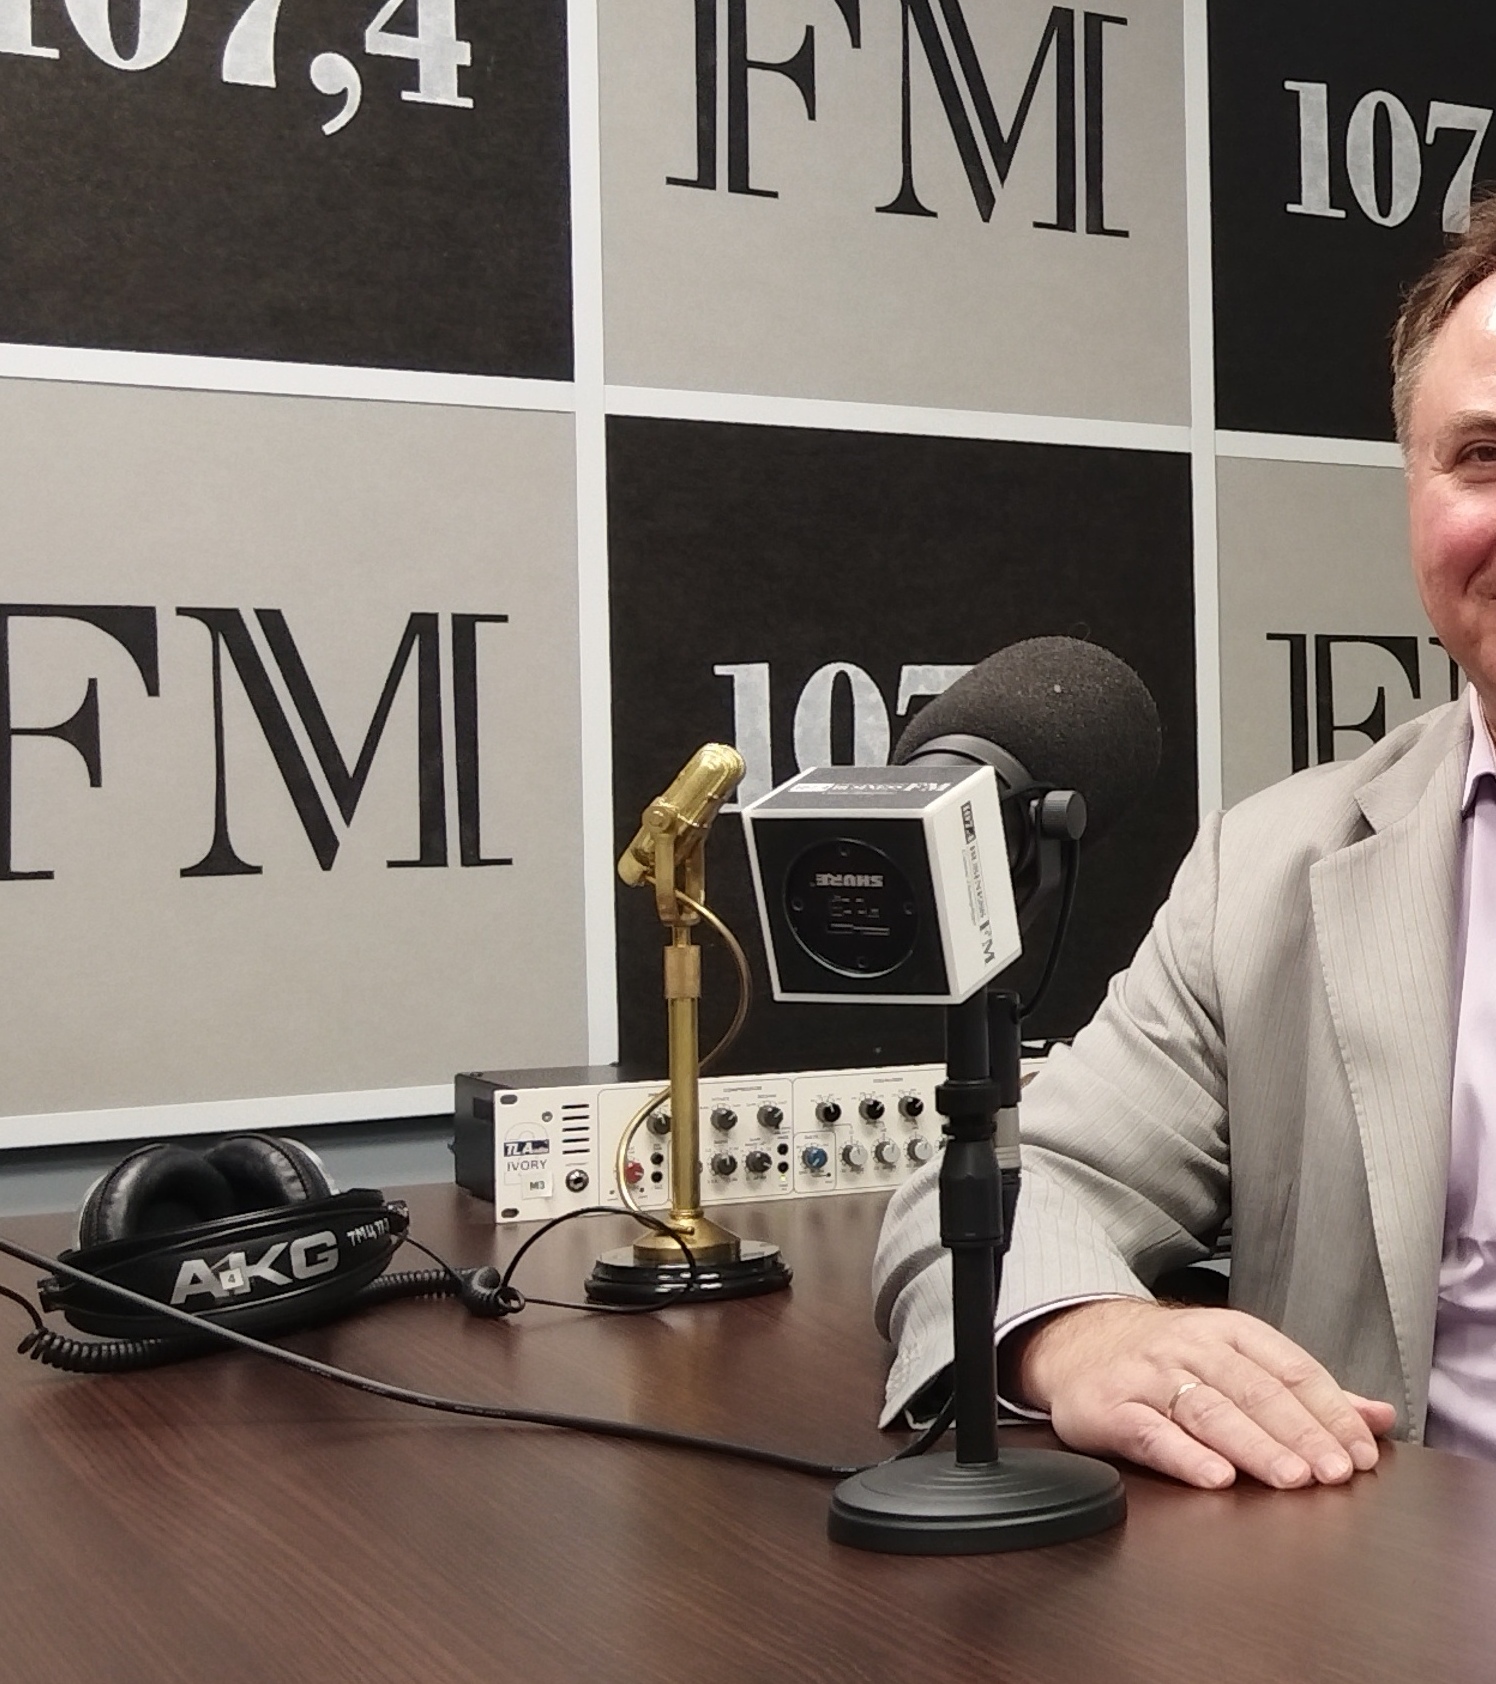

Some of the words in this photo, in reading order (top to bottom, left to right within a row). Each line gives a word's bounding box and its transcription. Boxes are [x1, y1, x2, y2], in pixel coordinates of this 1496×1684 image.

[0, 0, 474, 136] 7,4
[666, 0, 1130, 238] FM
[1266, 632, 1460, 774] F
[0, 603, 513, 881] FM
[815, 873, 883, 888] SHURE
[979, 919, 996, 964] FM
[506, 1159, 548, 1172] IVORY
[170, 1230, 339, 1305] AKG
[227, 1273, 237, 1284] 4
